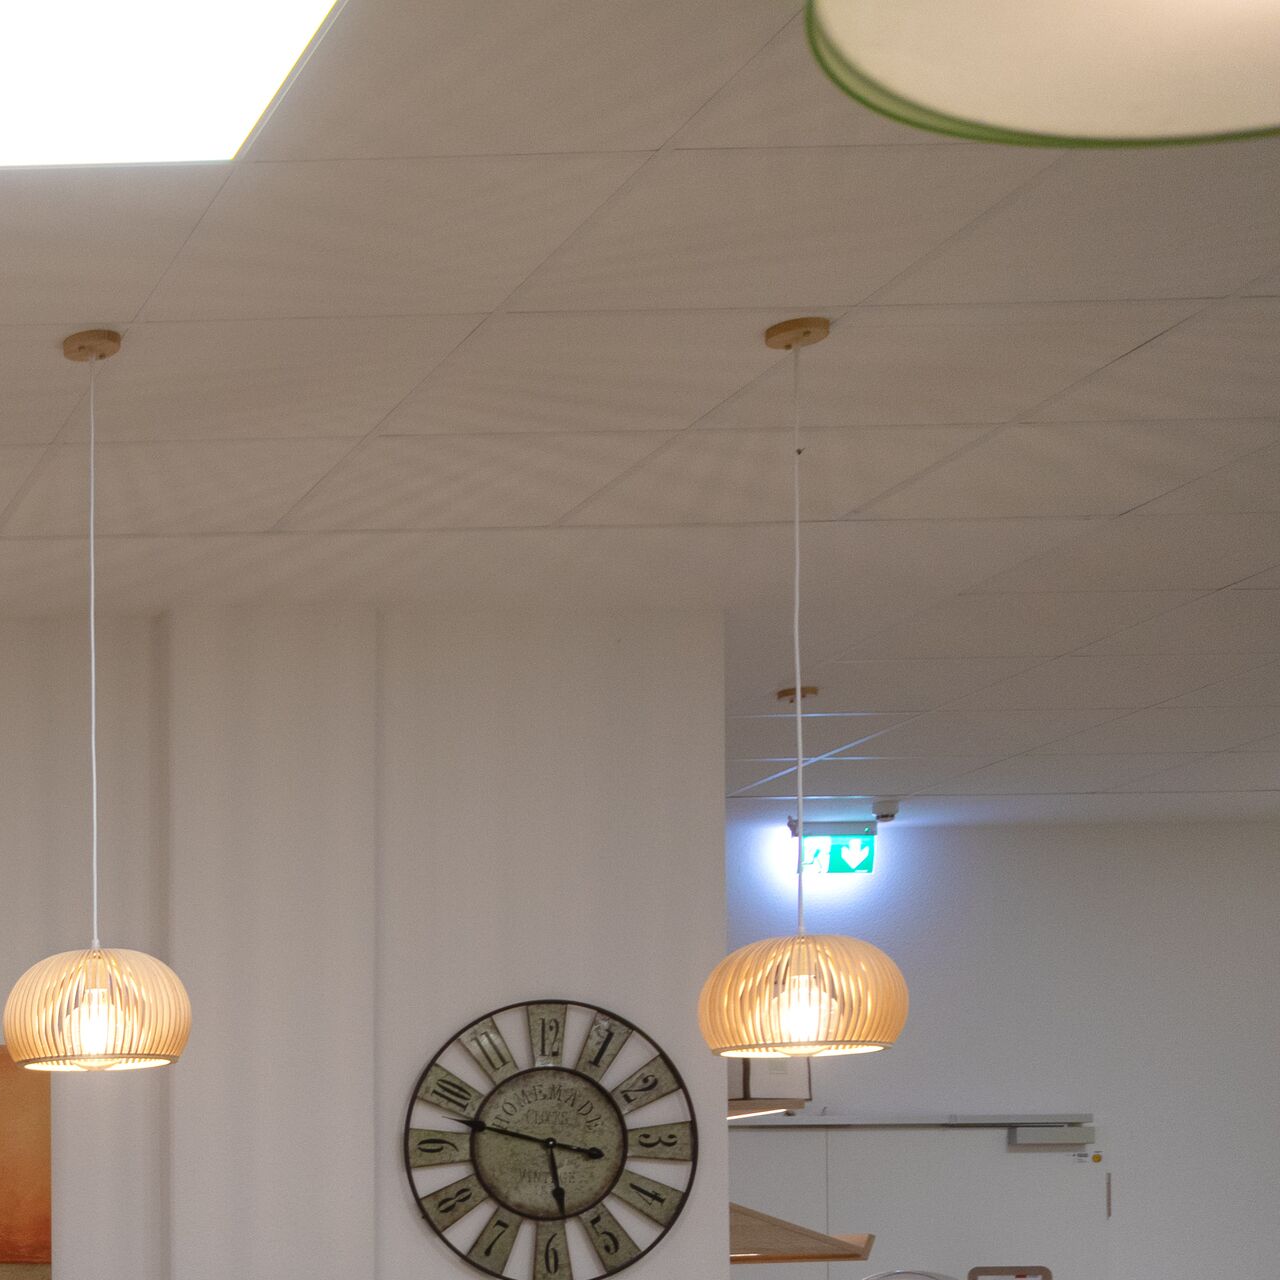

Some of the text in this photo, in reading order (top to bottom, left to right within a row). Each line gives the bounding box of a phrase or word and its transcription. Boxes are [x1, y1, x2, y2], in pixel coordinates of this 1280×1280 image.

[470, 1031, 512, 1071] 11
[538, 1017, 560, 1057] 12
[588, 1028, 615, 1068] 1
[431, 1078, 472, 1112] 10
[620, 1074, 659, 1104] 2
[638, 1133, 678, 1148] 3
[438, 1188, 472, 1213] 8
[629, 1183, 666, 1206] 4
[484, 1219, 509, 1257] 7
[544, 1232, 559, 1274] 6
[590, 1215, 619, 1255] 5
